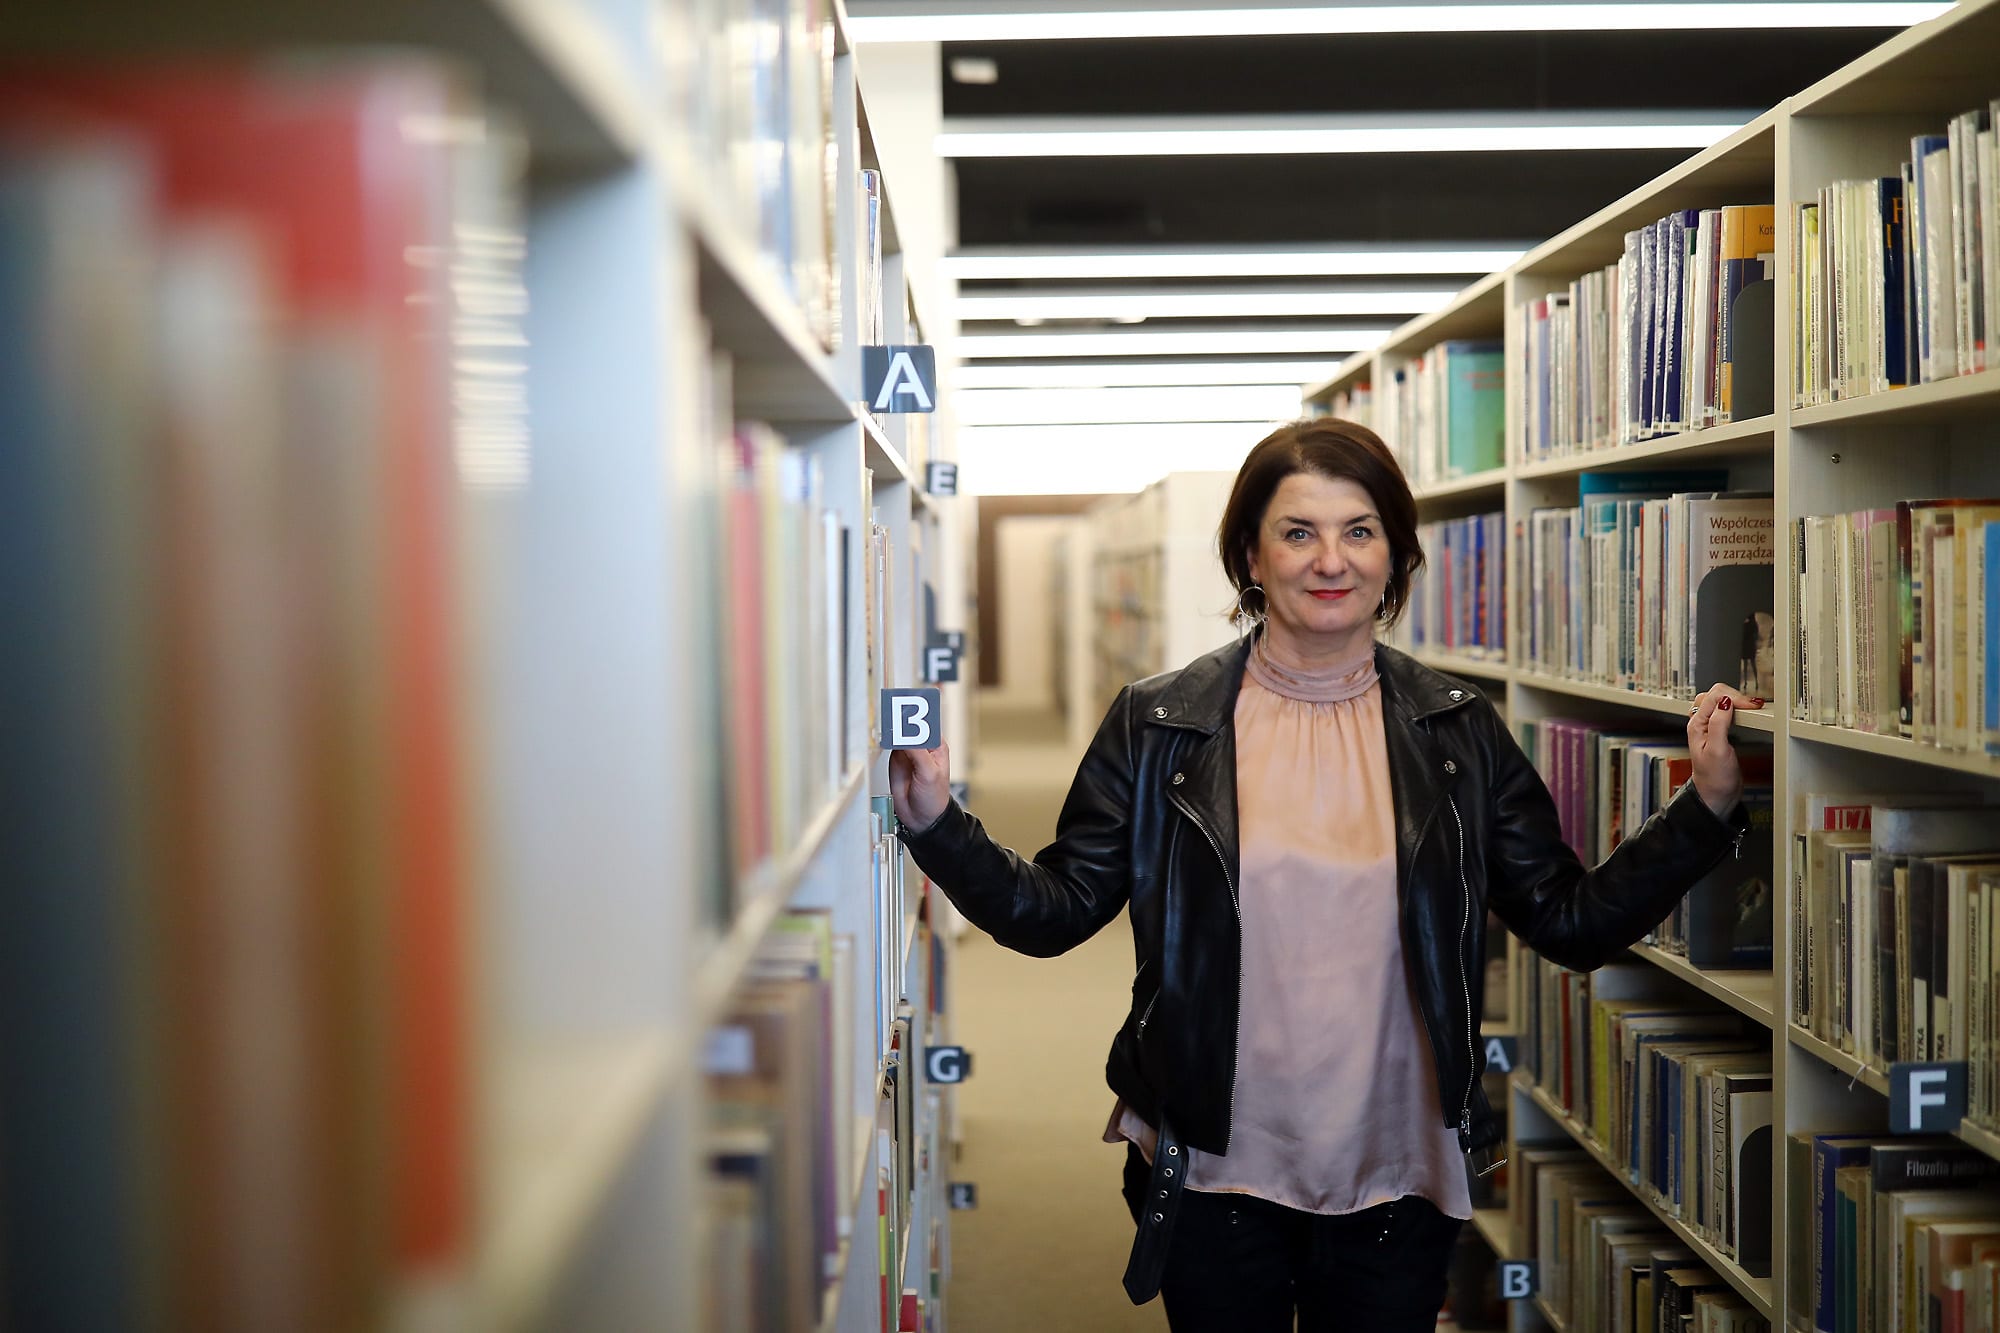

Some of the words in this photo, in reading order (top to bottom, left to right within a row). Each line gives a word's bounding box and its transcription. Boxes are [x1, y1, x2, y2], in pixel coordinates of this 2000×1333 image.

[874, 352, 933, 409] A
[930, 464, 956, 494] E
[1709, 532, 1767, 546] tendencje
[1710, 516, 1774, 531] Współczes
[1709, 550, 1719, 560] w
[1723, 548, 1774, 560] zarządza
[928, 648, 952, 681] F
[891, 695, 931, 746] B
[929, 1049, 960, 1082] G
[1486, 1039, 1511, 1072] A
[1908, 1070, 1948, 1130] F
[1712, 1087, 1725, 1192] DESCARTES
[1816, 1152, 1825, 1207] Filozofia
[1906, 1160, 1949, 1177] Filozofia
[1503, 1264, 1531, 1298] B
